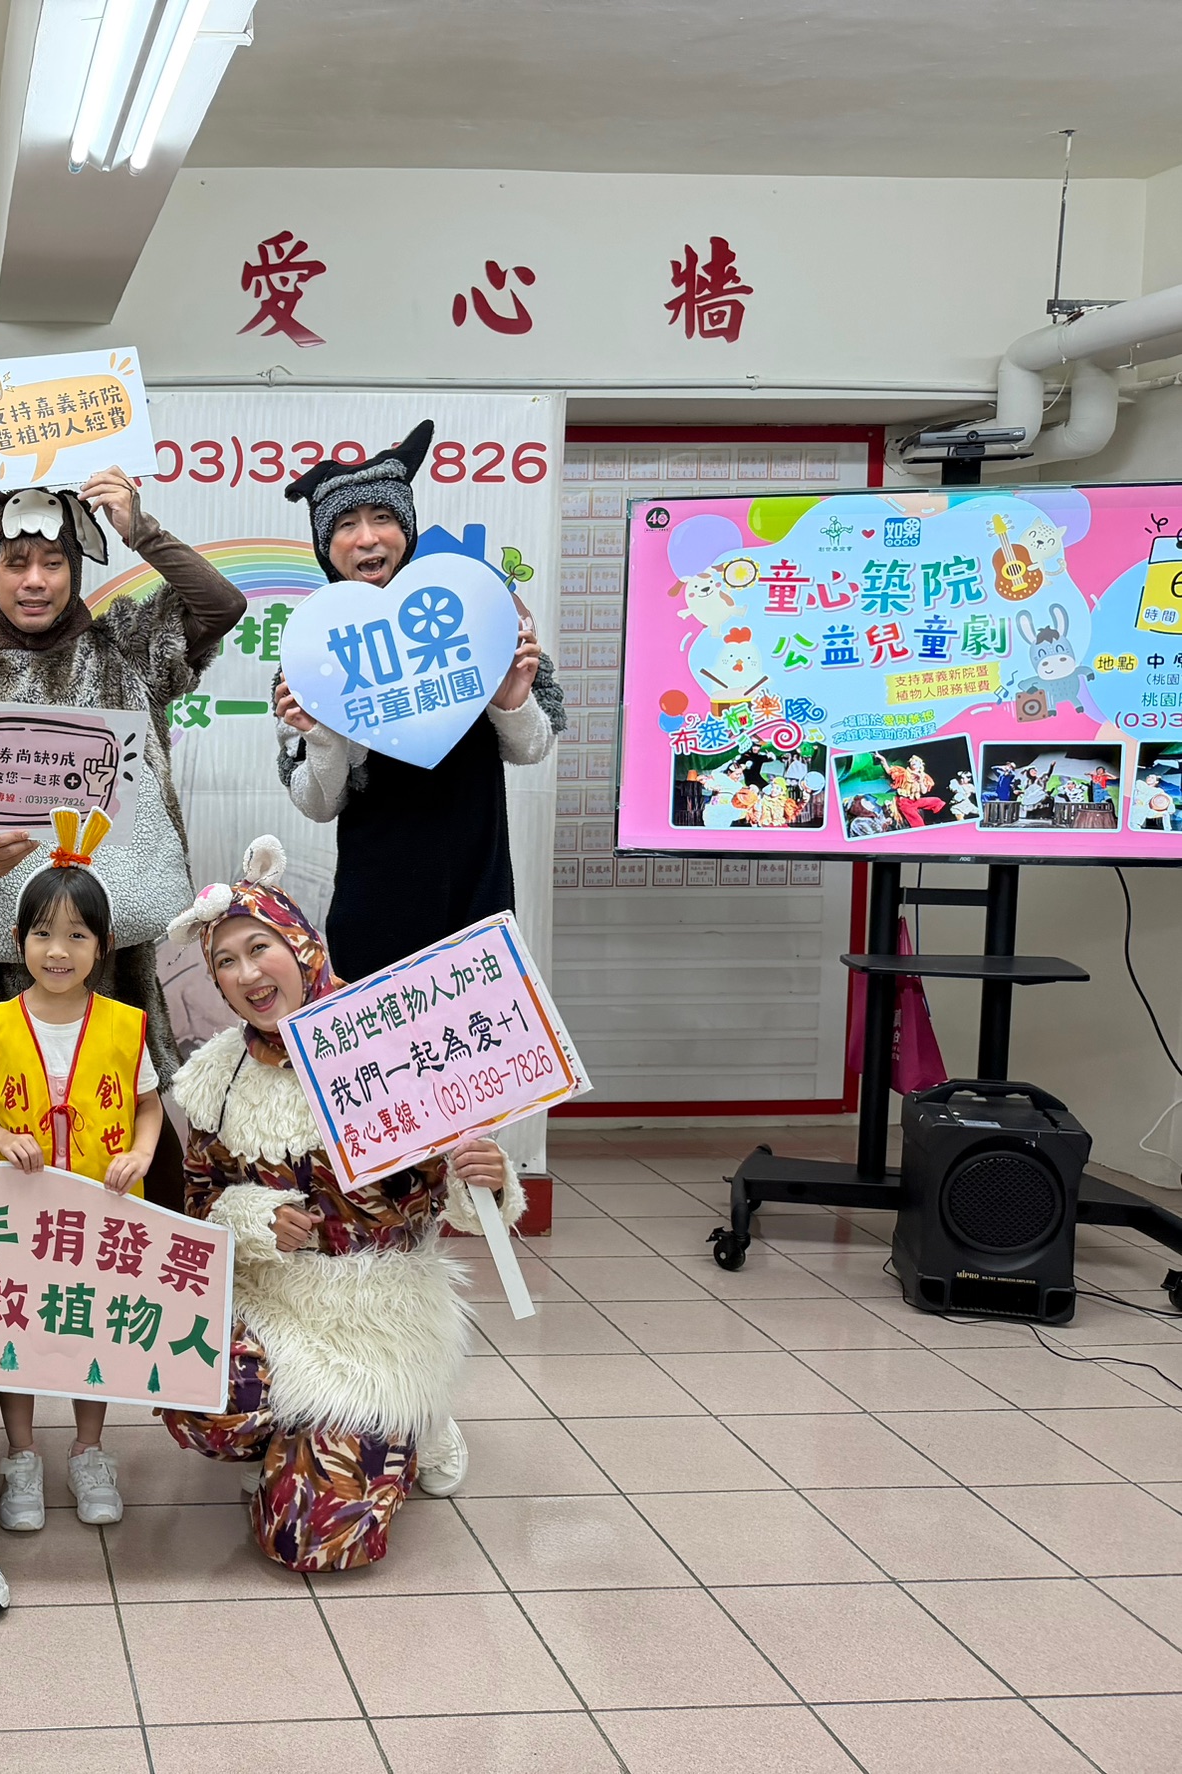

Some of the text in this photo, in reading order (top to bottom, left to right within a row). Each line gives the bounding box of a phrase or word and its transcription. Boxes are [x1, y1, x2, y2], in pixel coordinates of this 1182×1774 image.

[759, 555, 984, 616] 童心築院
[1145, 608, 1176, 623] 時間
[326, 586, 471, 696] 如果
[771, 613, 1011, 670] 公益兒童劇
[1098, 655, 1135, 671] 地點
[343, 665, 485, 734] 兒童劇團
[895, 664, 989, 688] 支持嘉義新院暨
[896, 680, 990, 702] 植物人服務經費
[312, 948, 503, 1061] 為創世植物人加油
[330, 999, 529, 1116] 我們一起為愛+1
[95, 1071, 126, 1156] 創世
